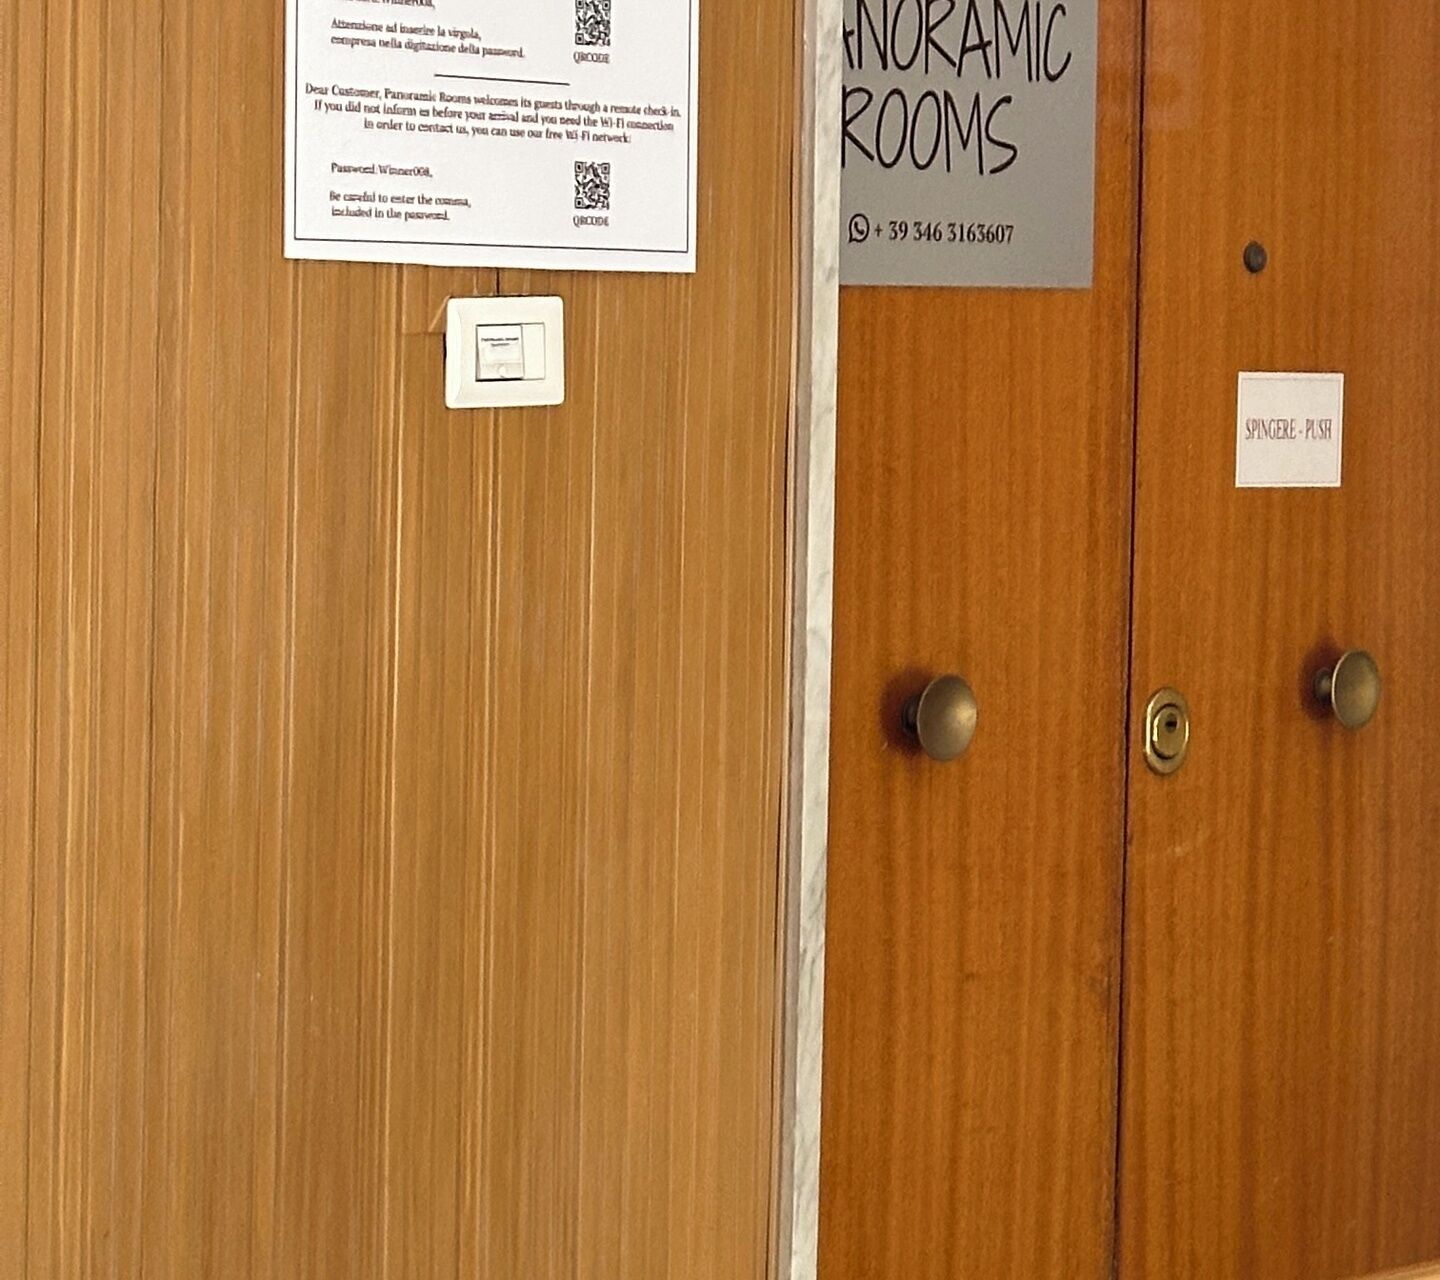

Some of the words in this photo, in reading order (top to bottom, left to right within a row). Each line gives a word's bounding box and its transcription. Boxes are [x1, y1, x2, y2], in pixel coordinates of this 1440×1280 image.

[305, 82, 329, 95] Dear
[324, 103, 342, 114] you
[363, 104, 380, 114] not
[432, 106, 462, 118] before
[464, 111, 485, 122] your
[521, 112, 538, 123] and
[540, 116, 557, 126] you
[559, 114, 581, 125] need
[583, 115, 598, 126] the
[376, 118, 403, 130] order
[471, 127, 488, 137] you
[490, 128, 507, 136] can
[509, 129, 525, 137] use
[545, 128, 562, 139] free
[841, 83, 1019, 176] ROOMS
[888, 220, 908, 241] 39
[913, 221, 943, 243] 346
[947, 222, 1015, 245] 3163607
[1245, 418, 1297, 440] SPINGERE
[1305, 418, 1332, 440] PUSH
